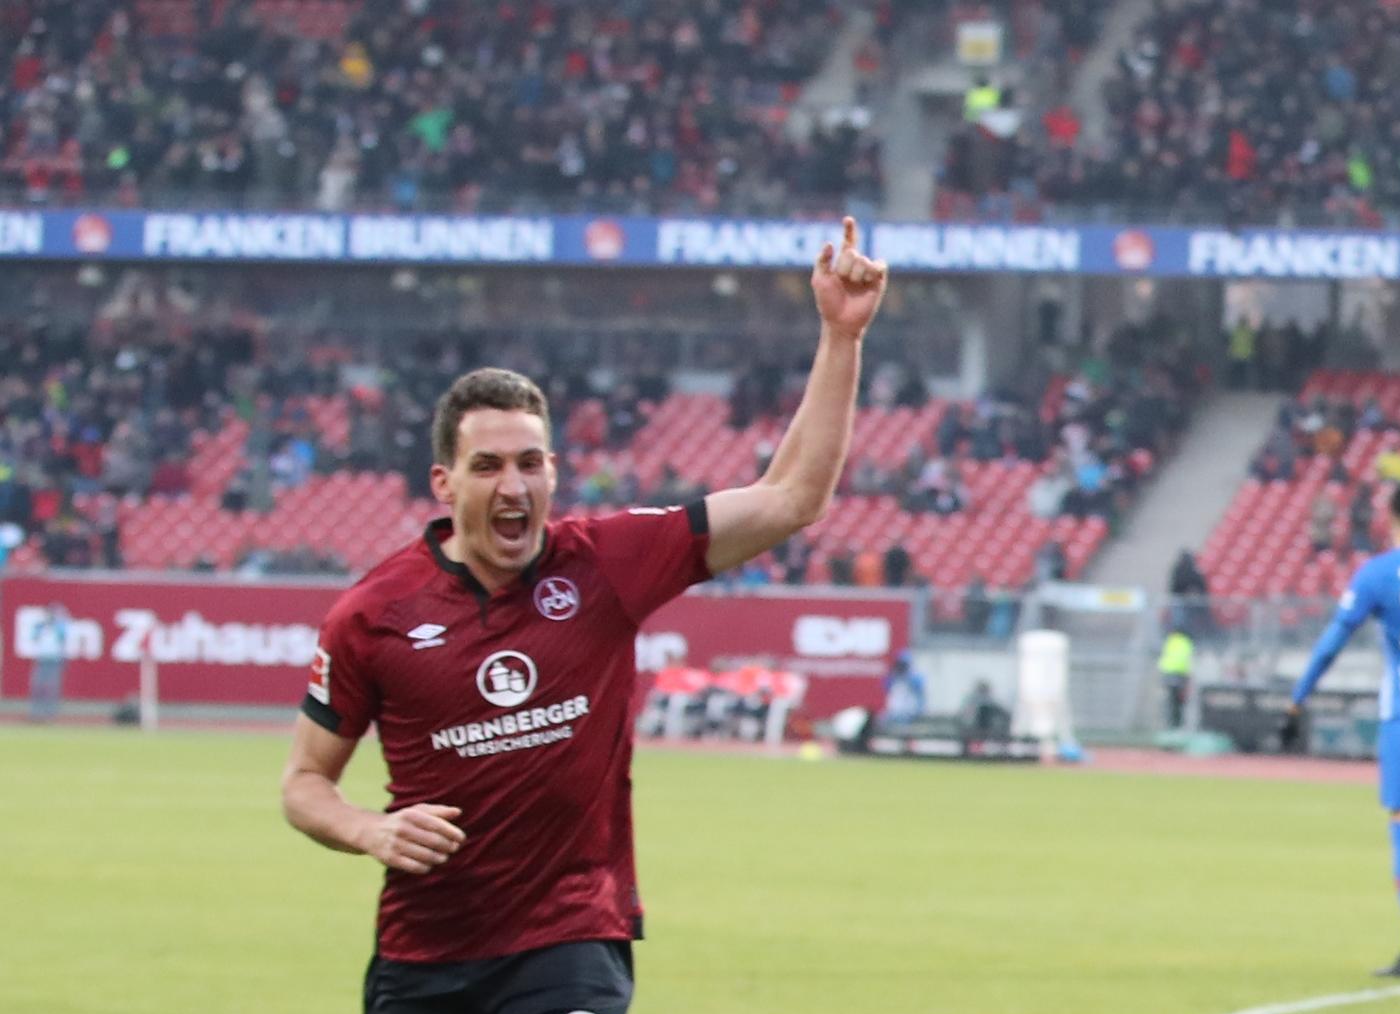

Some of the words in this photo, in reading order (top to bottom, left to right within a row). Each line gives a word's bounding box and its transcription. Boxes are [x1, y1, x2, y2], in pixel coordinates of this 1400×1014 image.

[143, 212, 343, 258] FRANKEN
[350, 215, 553, 260] BRUNNEN
[871, 223, 1080, 270] BRUNNEN
[1188, 231, 1400, 278] FRANKEN
[111, 608, 320, 666] Zuhaus
[456, 725, 573, 758] VERSICHERUNG
